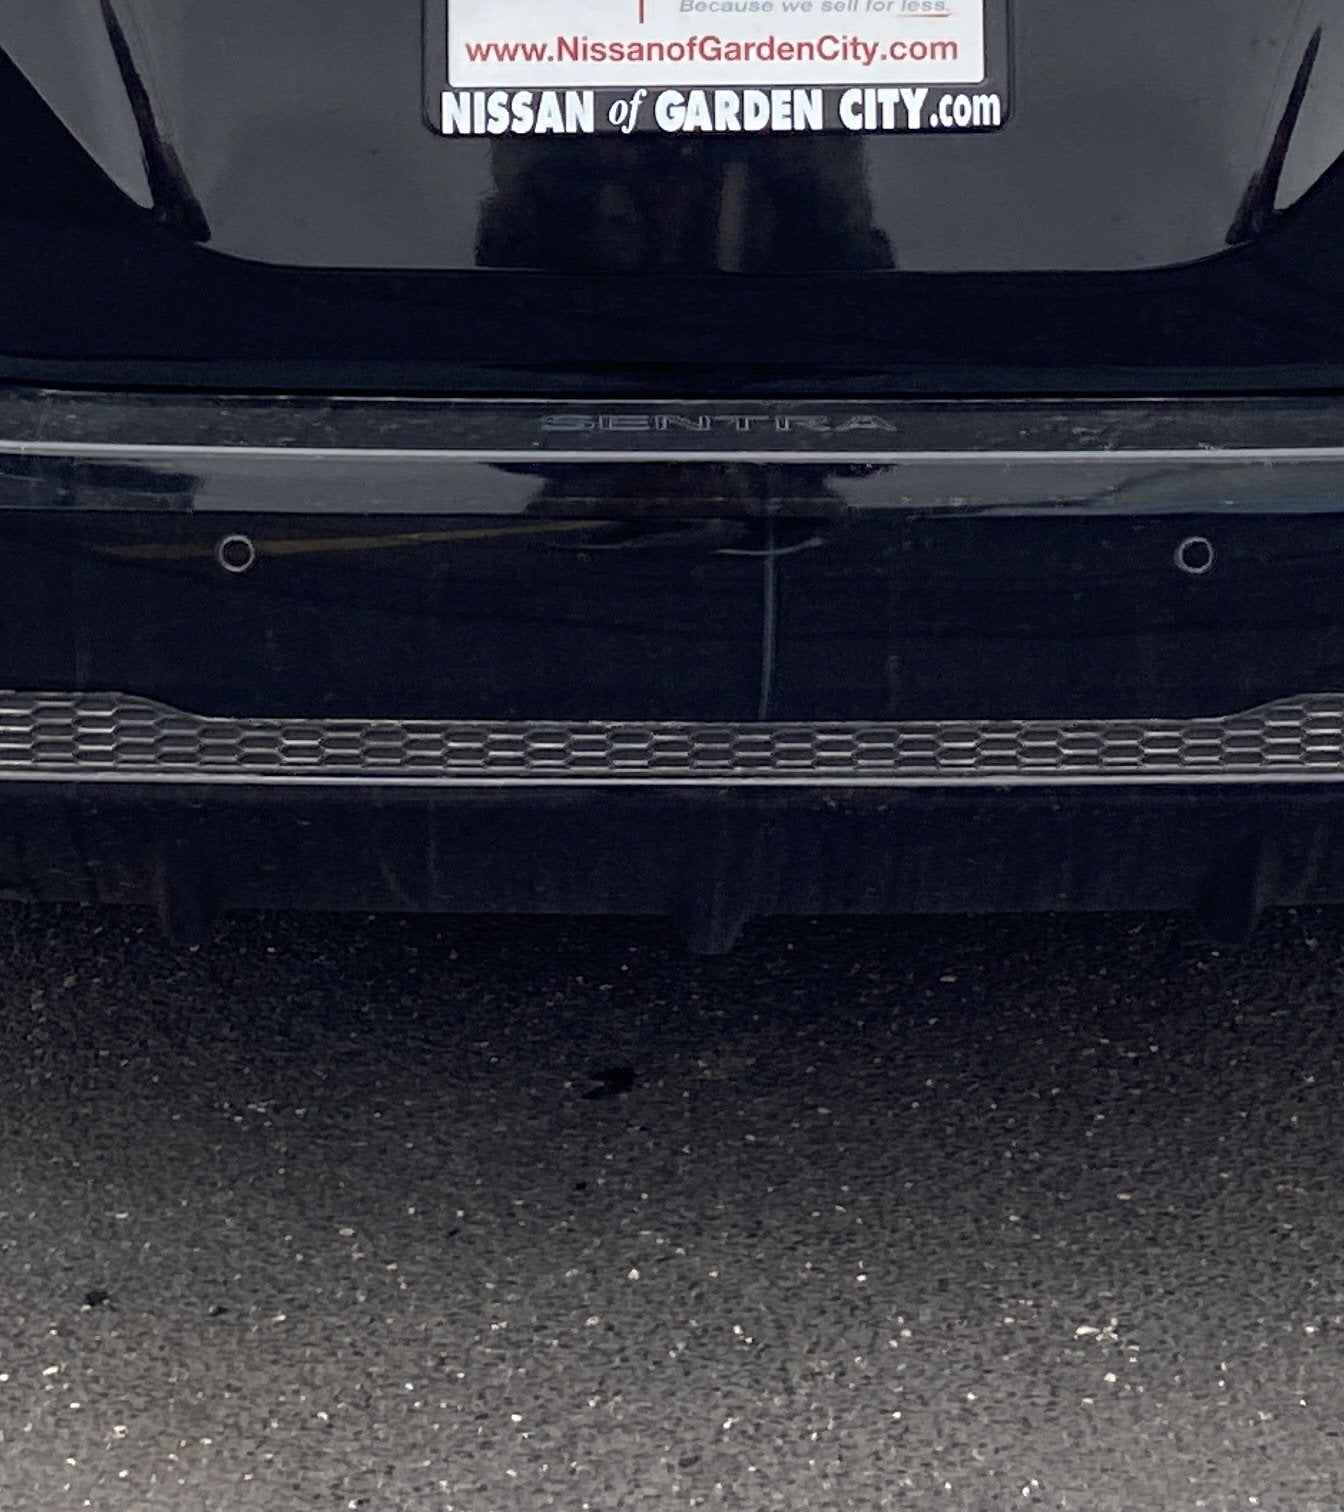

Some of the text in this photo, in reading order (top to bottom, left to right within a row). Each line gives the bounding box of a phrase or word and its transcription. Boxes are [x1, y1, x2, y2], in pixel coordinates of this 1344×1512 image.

[782, 1, 813, 13] we
[465, 36, 958, 66] www.NissanofGardenCity.com
[441, 88, 1001, 135] NISSAN of GARDEN CITY.com
[541, 414, 898, 432] SENTRA
